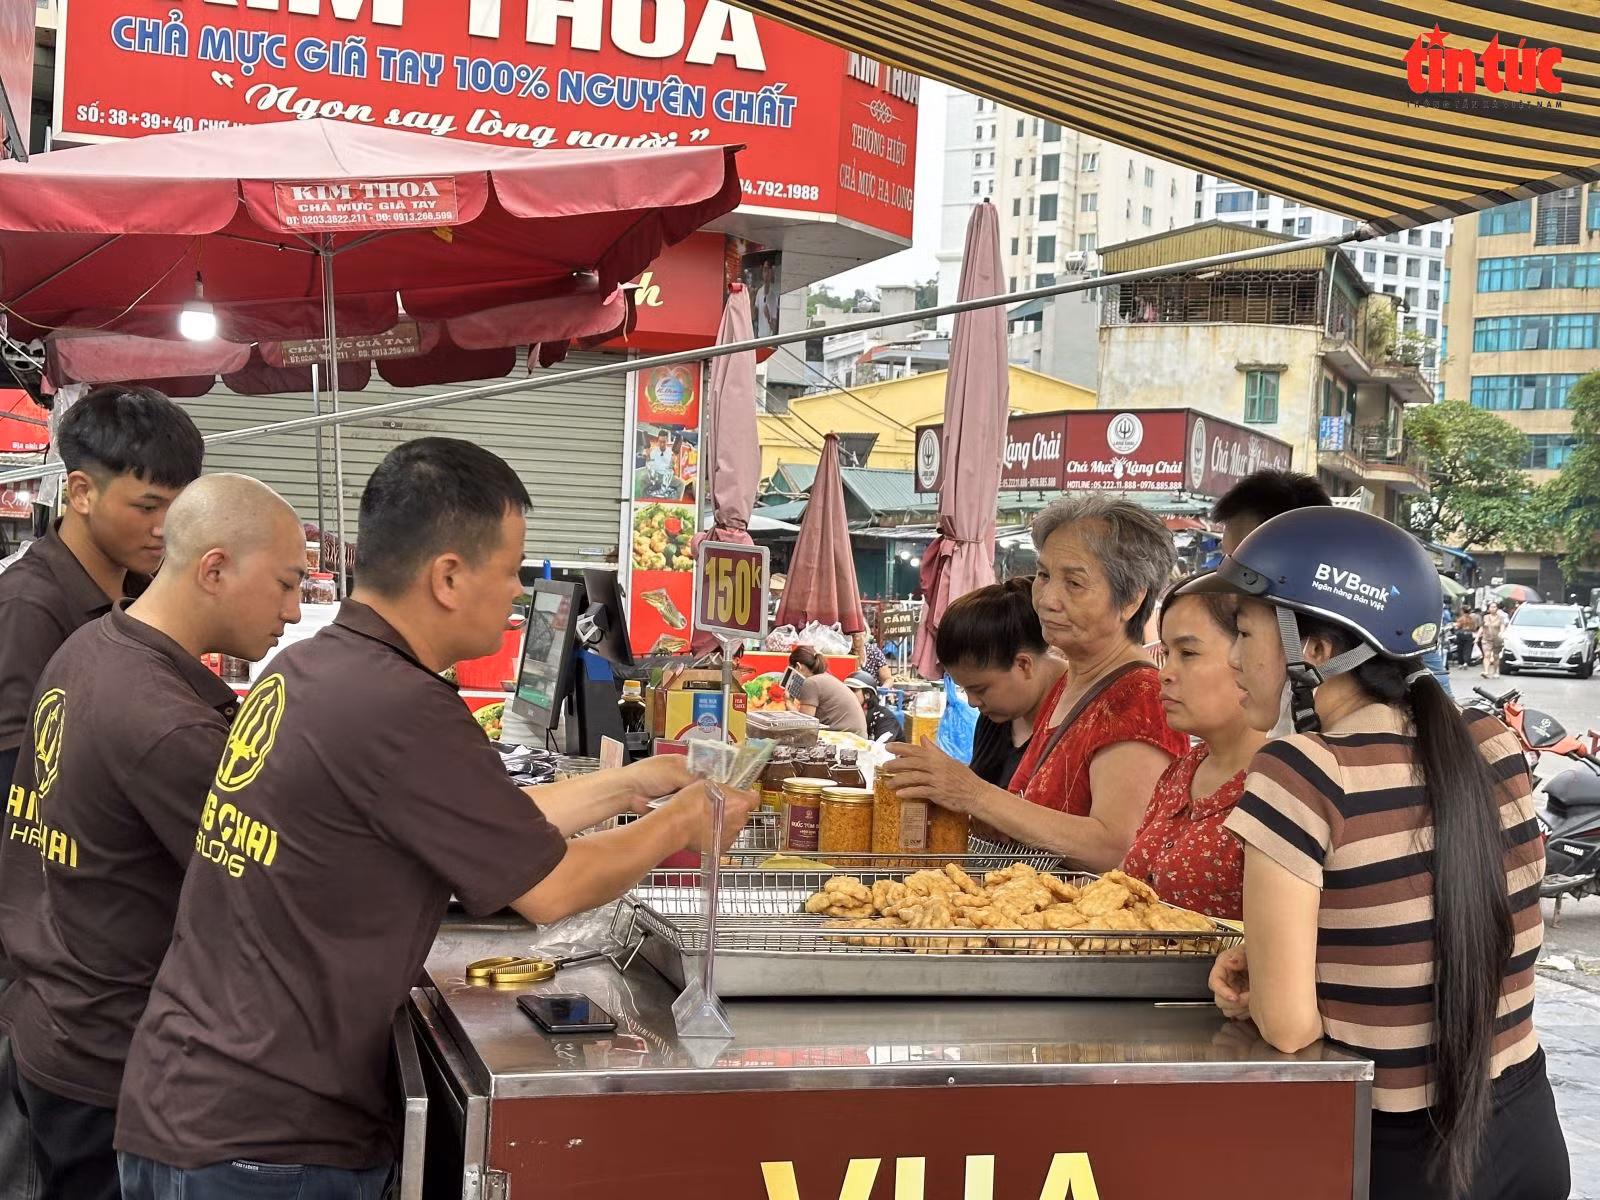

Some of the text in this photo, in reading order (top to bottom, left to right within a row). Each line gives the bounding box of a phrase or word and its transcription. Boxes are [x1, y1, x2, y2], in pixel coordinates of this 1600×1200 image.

[111, 8, 188, 58] CHẢ
[198, 25, 286, 76] MỰC
[295, 35, 368, 78] GIÃ
[376, 46, 445, 87] TAY
[453, 56, 550, 99] 100%
[557, 69, 706, 118] NGUYÊN
[712, 82, 798, 128] CHẤT
[76, 101, 105, 123] SỐ:
[383, 107, 457, 136] say
[465, 108, 558, 148] lòng
[290, 180, 440, 201] KIM THOA
[891, 182, 913, 212] LONG
[411, 200, 436, 209] TAY
[1125, 461, 1154, 477] Làng
[1315, 563, 1390, 603] BVBank
